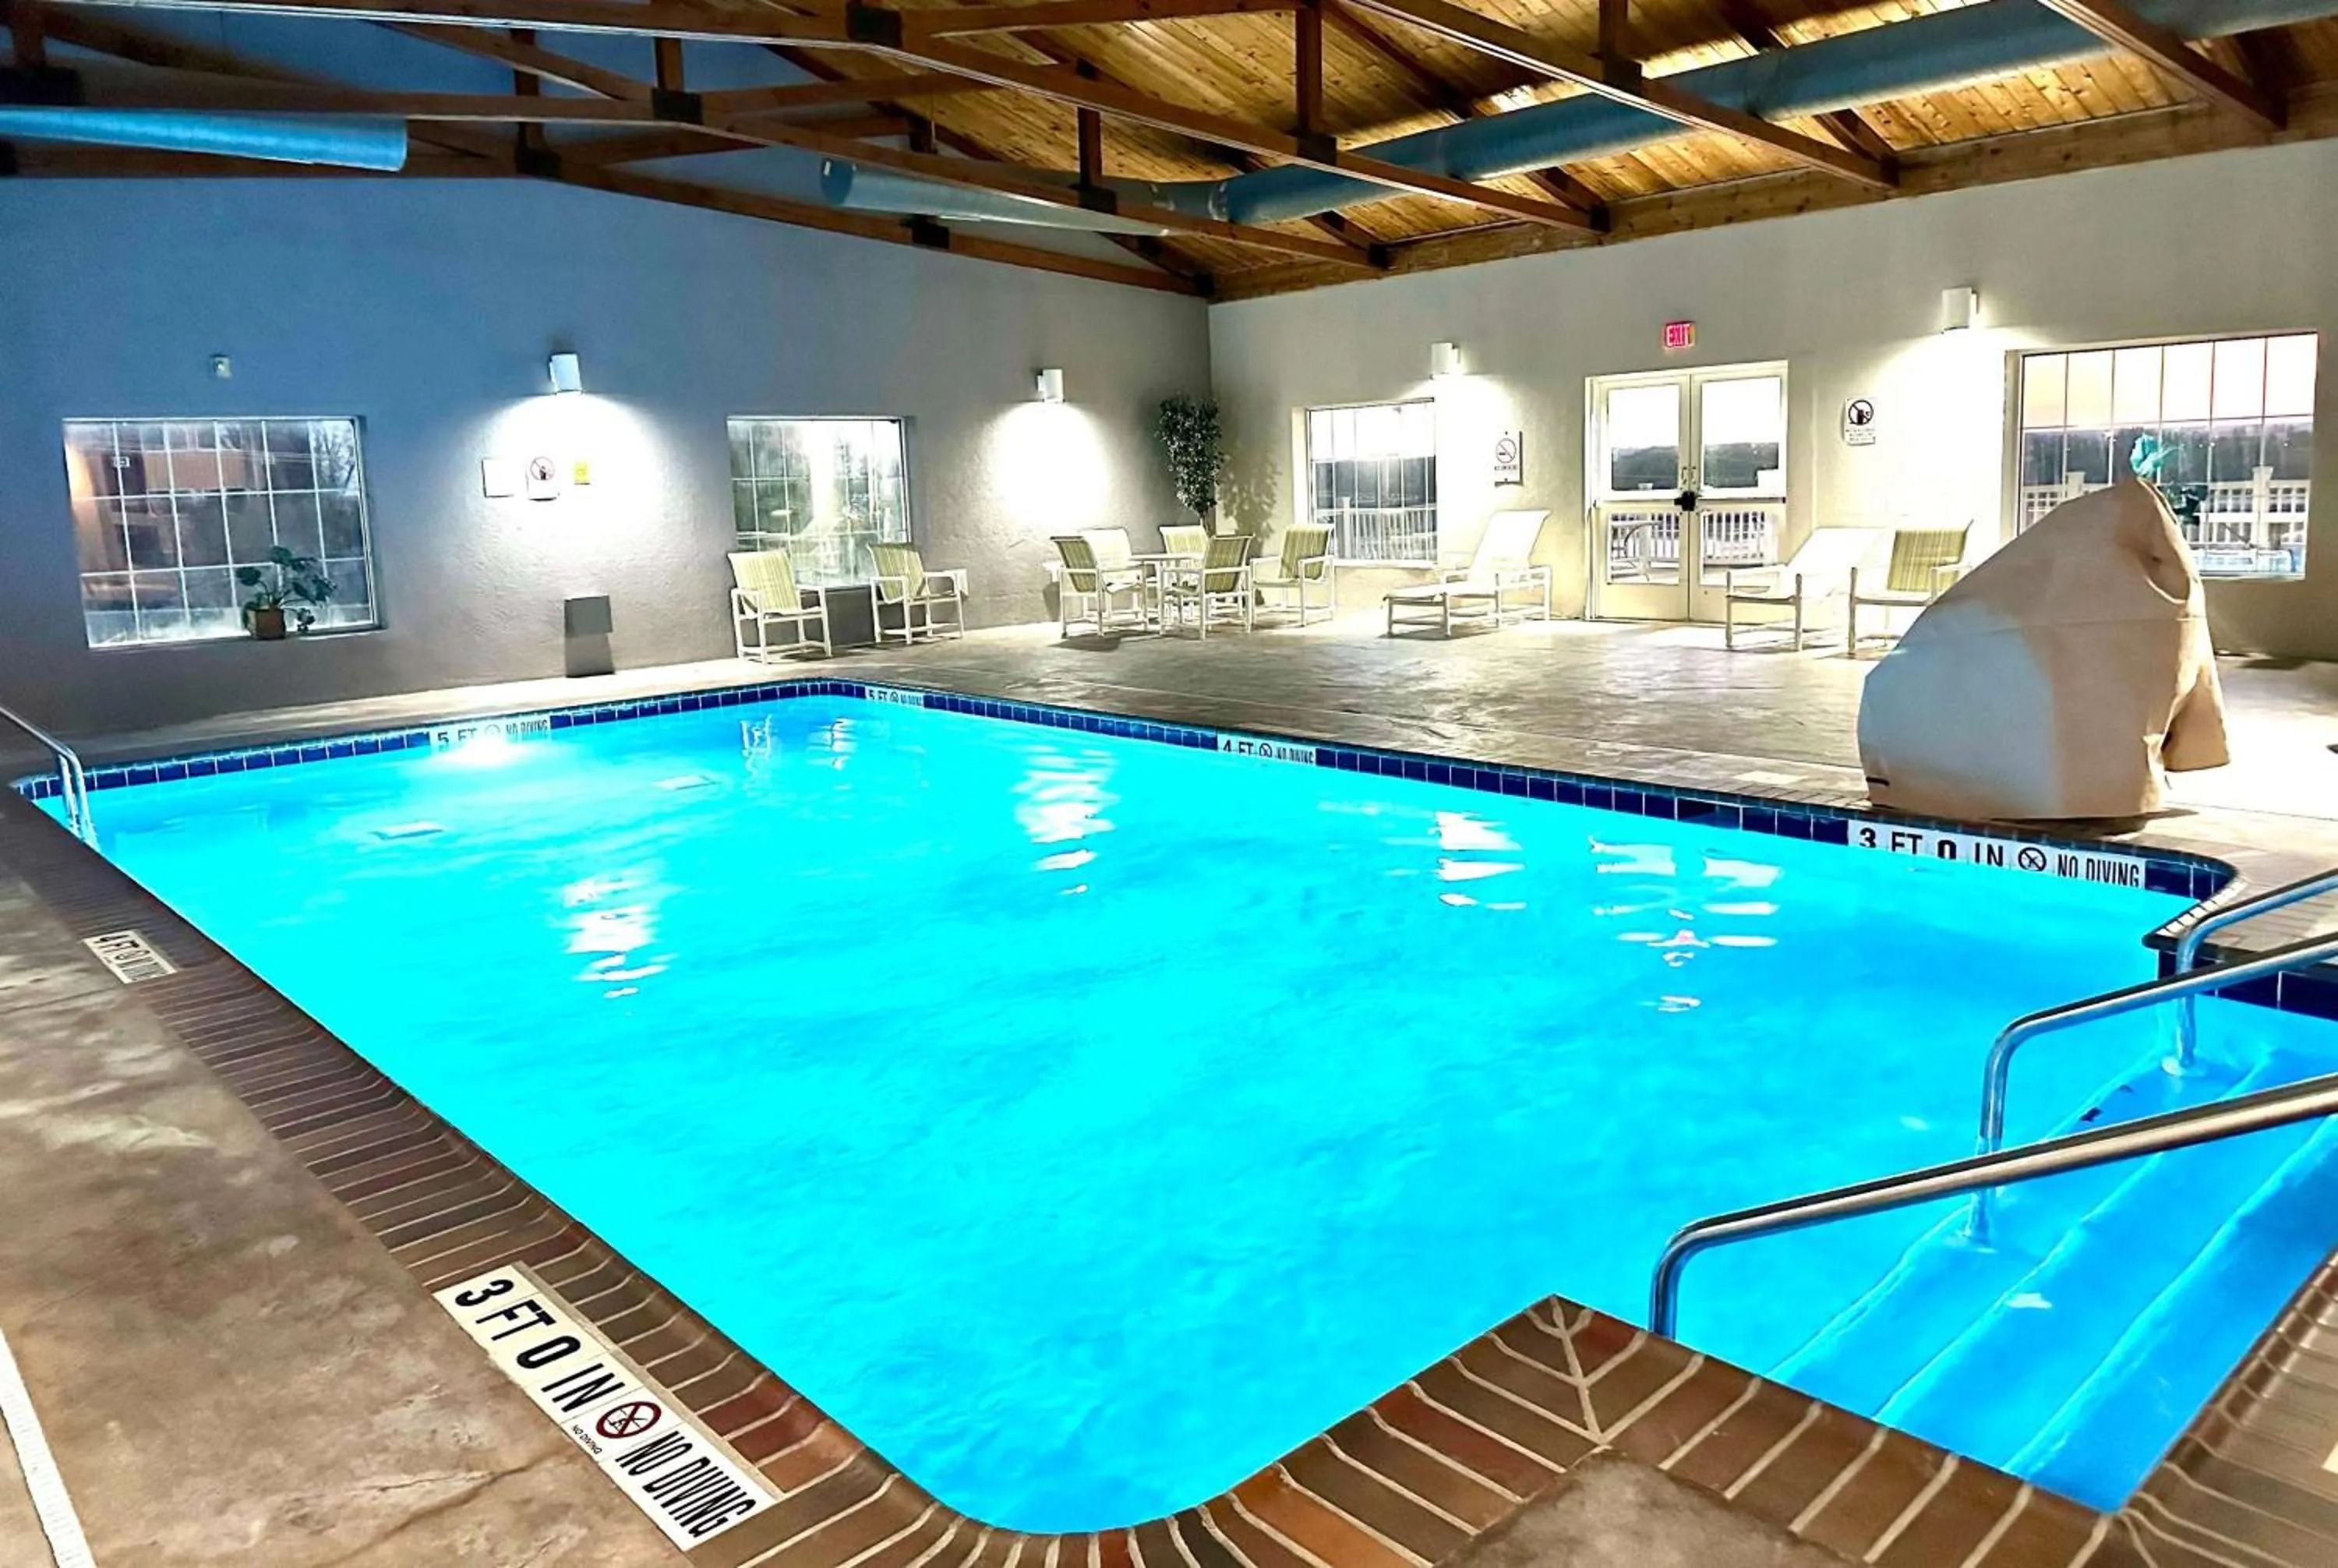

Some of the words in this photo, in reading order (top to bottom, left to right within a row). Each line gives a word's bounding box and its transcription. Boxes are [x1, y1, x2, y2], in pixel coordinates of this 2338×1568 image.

[1667, 324, 1690, 347] EXIT
[437, 731, 450, 743] 5
[457, 728, 477, 741] FT
[1223, 739, 1231, 752] 4
[1238, 741, 1254, 755] FT
[1859, 828, 1877, 849] 3
[1891, 831, 1923, 855] FT
[1975, 842, 2004, 867] IN
[2057, 854, 2078, 878] NO
[2085, 858, 2139, 888] DIVING
[454, 1278, 515, 1308] 3
[475, 1299, 556, 1341] FT
[541, 1363, 627, 1413] IN
[615, 1430, 693, 1477] NO
[642, 1457, 757, 1538] DIVING
